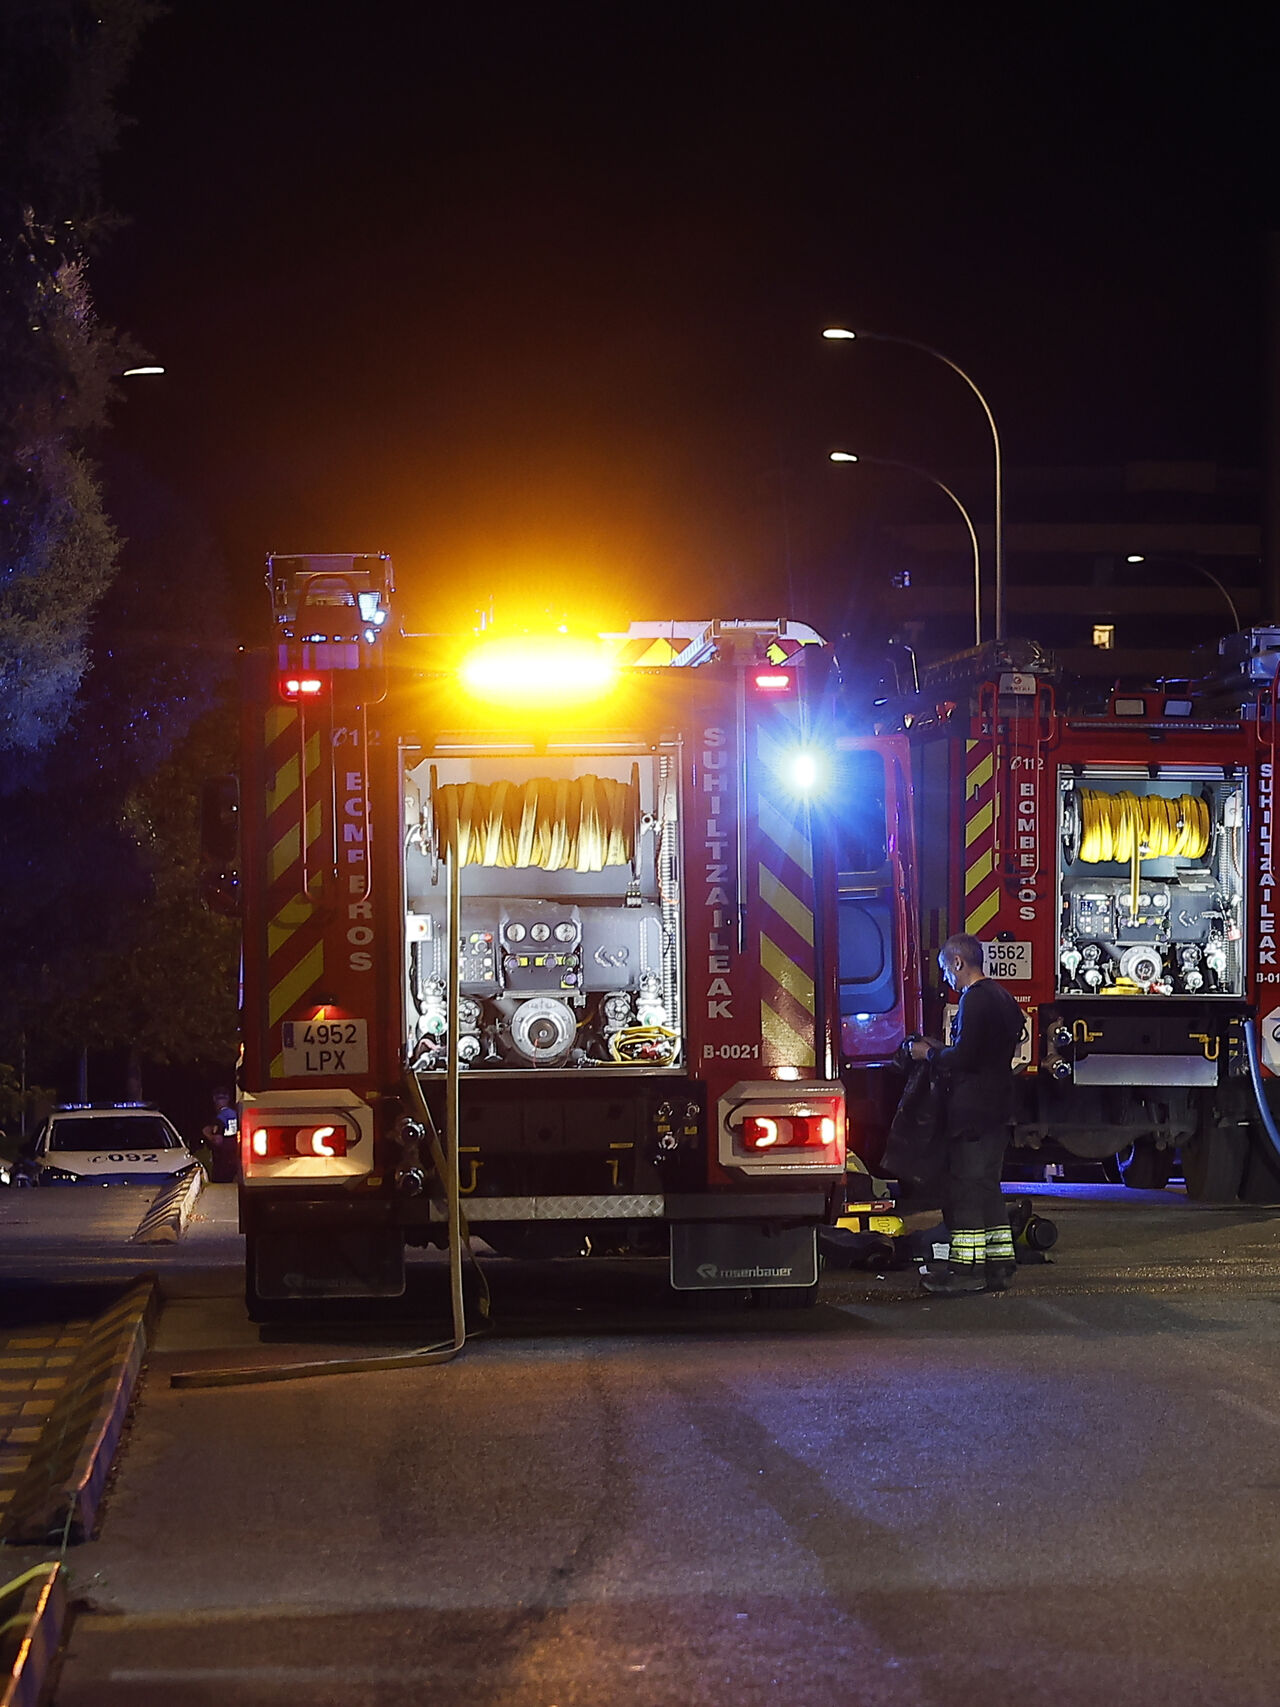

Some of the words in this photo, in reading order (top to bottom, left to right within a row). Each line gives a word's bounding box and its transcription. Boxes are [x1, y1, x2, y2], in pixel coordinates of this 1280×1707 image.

[348, 728, 381, 747] 12
[702, 727, 733, 1019] SUHILTZAILEAK
[1259, 764, 1277, 965] SUHILTZAILEAK
[988, 945, 1025, 960] 5562
[989, 962, 1017, 977] MBG
[303, 1023, 357, 1045] 4952
[703, 1044, 759, 1059] B-0021
[306, 1050, 345, 1071] LPX
[108, 1153, 159, 1163] 092
[720, 1265, 793, 1278] rosenbauer
